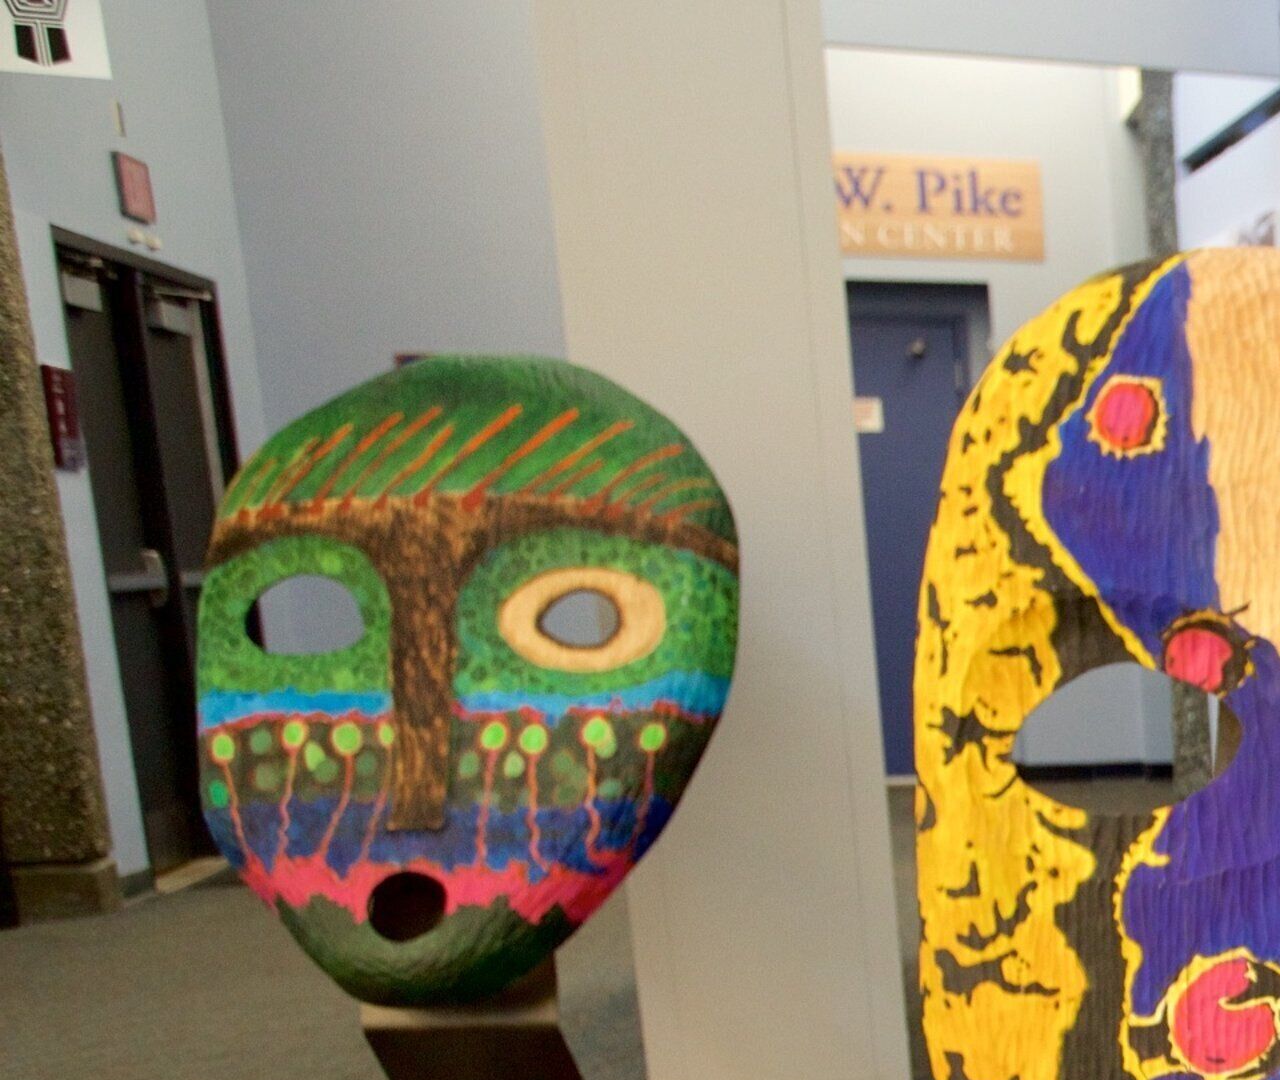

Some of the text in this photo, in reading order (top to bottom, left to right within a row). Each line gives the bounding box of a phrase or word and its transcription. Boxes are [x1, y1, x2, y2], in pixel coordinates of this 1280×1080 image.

[834, 164, 1023, 218] W. Pike
[876, 222, 1014, 254] CENTER
